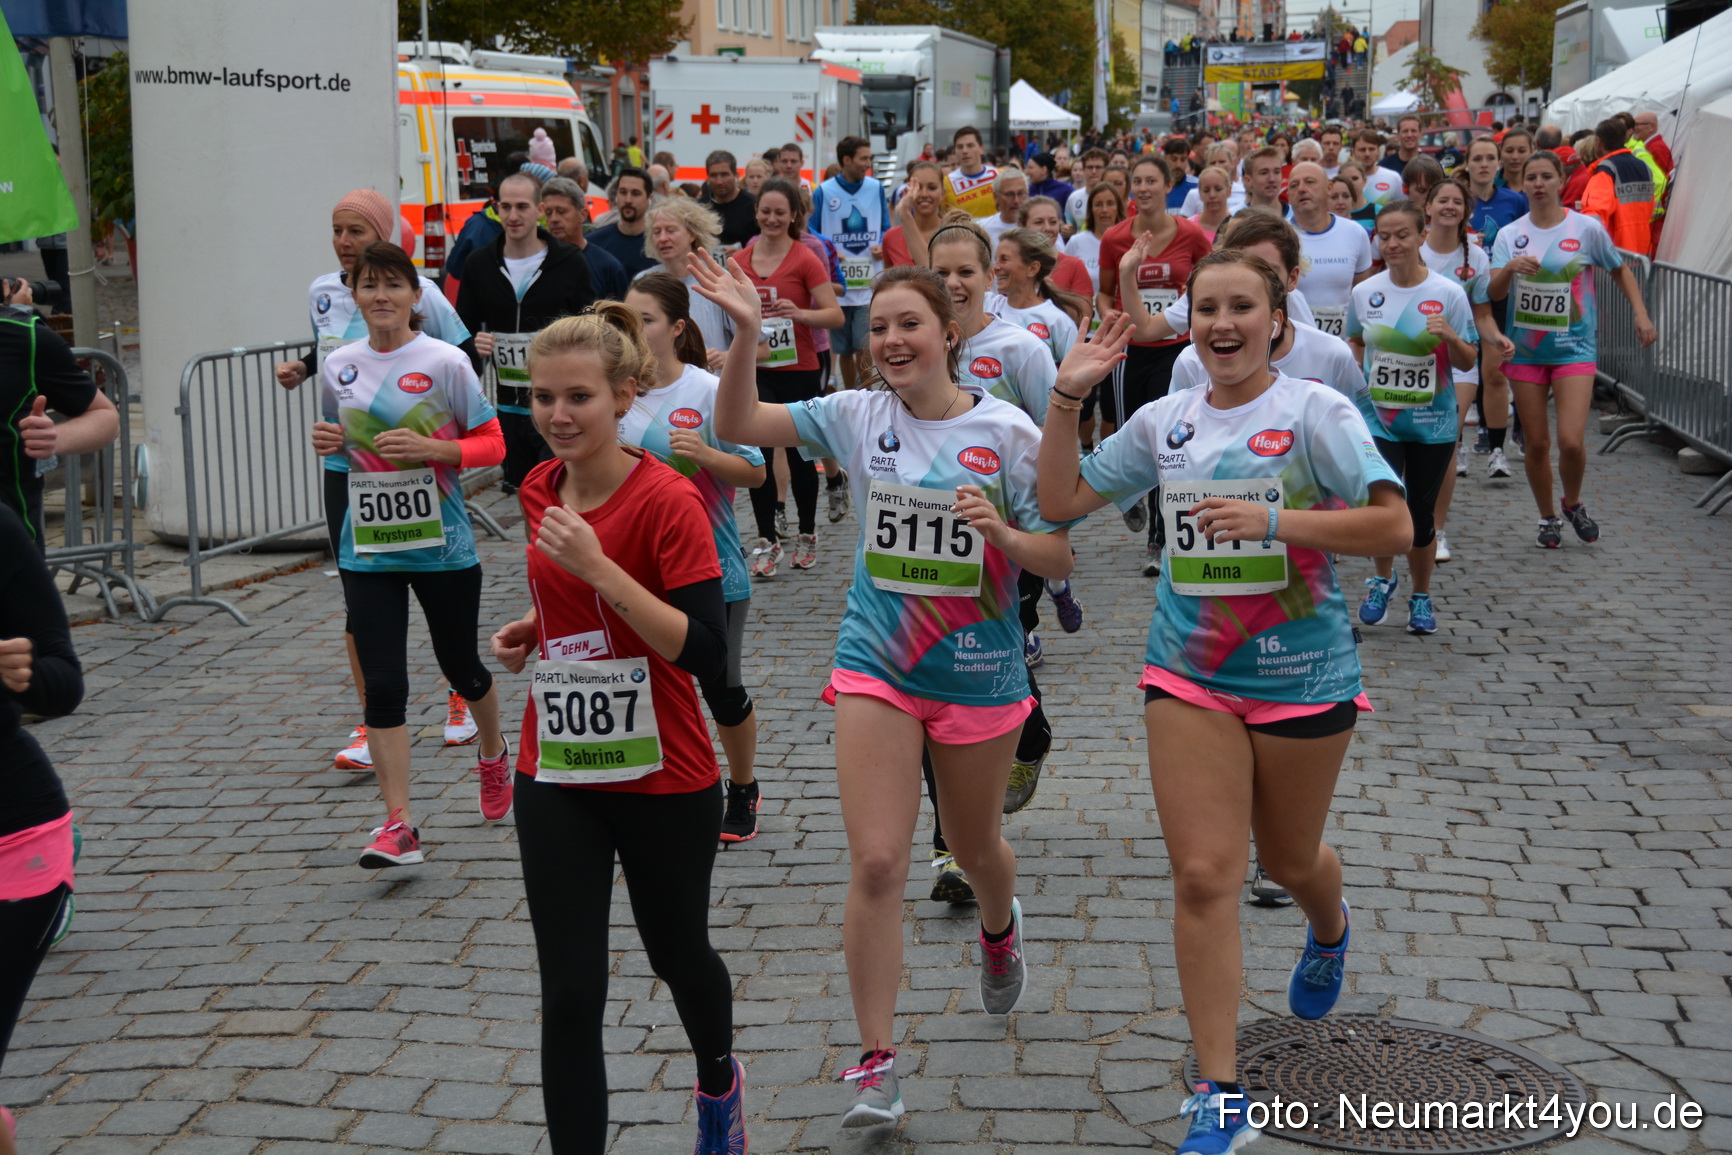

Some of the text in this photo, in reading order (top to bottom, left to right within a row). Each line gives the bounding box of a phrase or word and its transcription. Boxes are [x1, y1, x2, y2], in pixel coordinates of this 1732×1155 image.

[135, 65, 351, 92] www.bmw-laufsport.de
[1243, 67, 1284, 78] START
[725, 104, 780, 114] Bayerisches
[725, 116, 750, 124] Rotes
[725, 128, 751, 136] Kreuz
[957, 185, 995, 206] MAX BÖ
[829, 197, 841, 211] 9
[841, 265, 870, 278] 5057
[1519, 284, 1534, 293] PARTL
[1521, 293, 1566, 314] 5078
[1524, 314, 1557, 325] Elisabeth
[1314, 318, 1343, 336] 073
[768, 328, 791, 349] 84
[498, 346, 527, 367] 511
[1375, 355, 1426, 368] PARTL Neumarkt
[973, 361, 1000, 374] Hervis
[402, 377, 429, 390] Hervis
[1376, 365, 1430, 389] 5136
[1384, 391, 1417, 402] Claudia
[673, 412, 699, 424] Hervis
[1254, 435, 1291, 450] Hervis
[870, 455, 898, 467] PARTL
[964, 451, 998, 469] Hervis
[1158, 453, 1187, 464] PARTL
[868, 464, 897, 473] Neumarkt
[350, 477, 420, 489] PARTL Neumarkt
[870, 491, 956, 512] PARTL Neumar
[1166, 492, 1200, 503] PARTL
[359, 488, 432, 523] 5080
[373, 526, 423, 543] Krystyna
[876, 509, 974, 558] 5115
[901, 563, 939, 581] Lena
[1202, 562, 1242, 580] Anna
[955, 631, 982, 649] 16.
[1255, 635, 1288, 655] 16.
[562, 640, 590, 656] DEHN
[954, 649, 1011, 660] Neumarkter
[1256, 650, 1325, 666] Neumarkter
[953, 661, 1002, 673] Stadtlauf
[1258, 662, 1313, 676] Stadtlauf
[534, 672, 626, 684] PARTL Neumarkt
[543, 689, 639, 737] 5087
[563, 747, 626, 766] Sabrina
